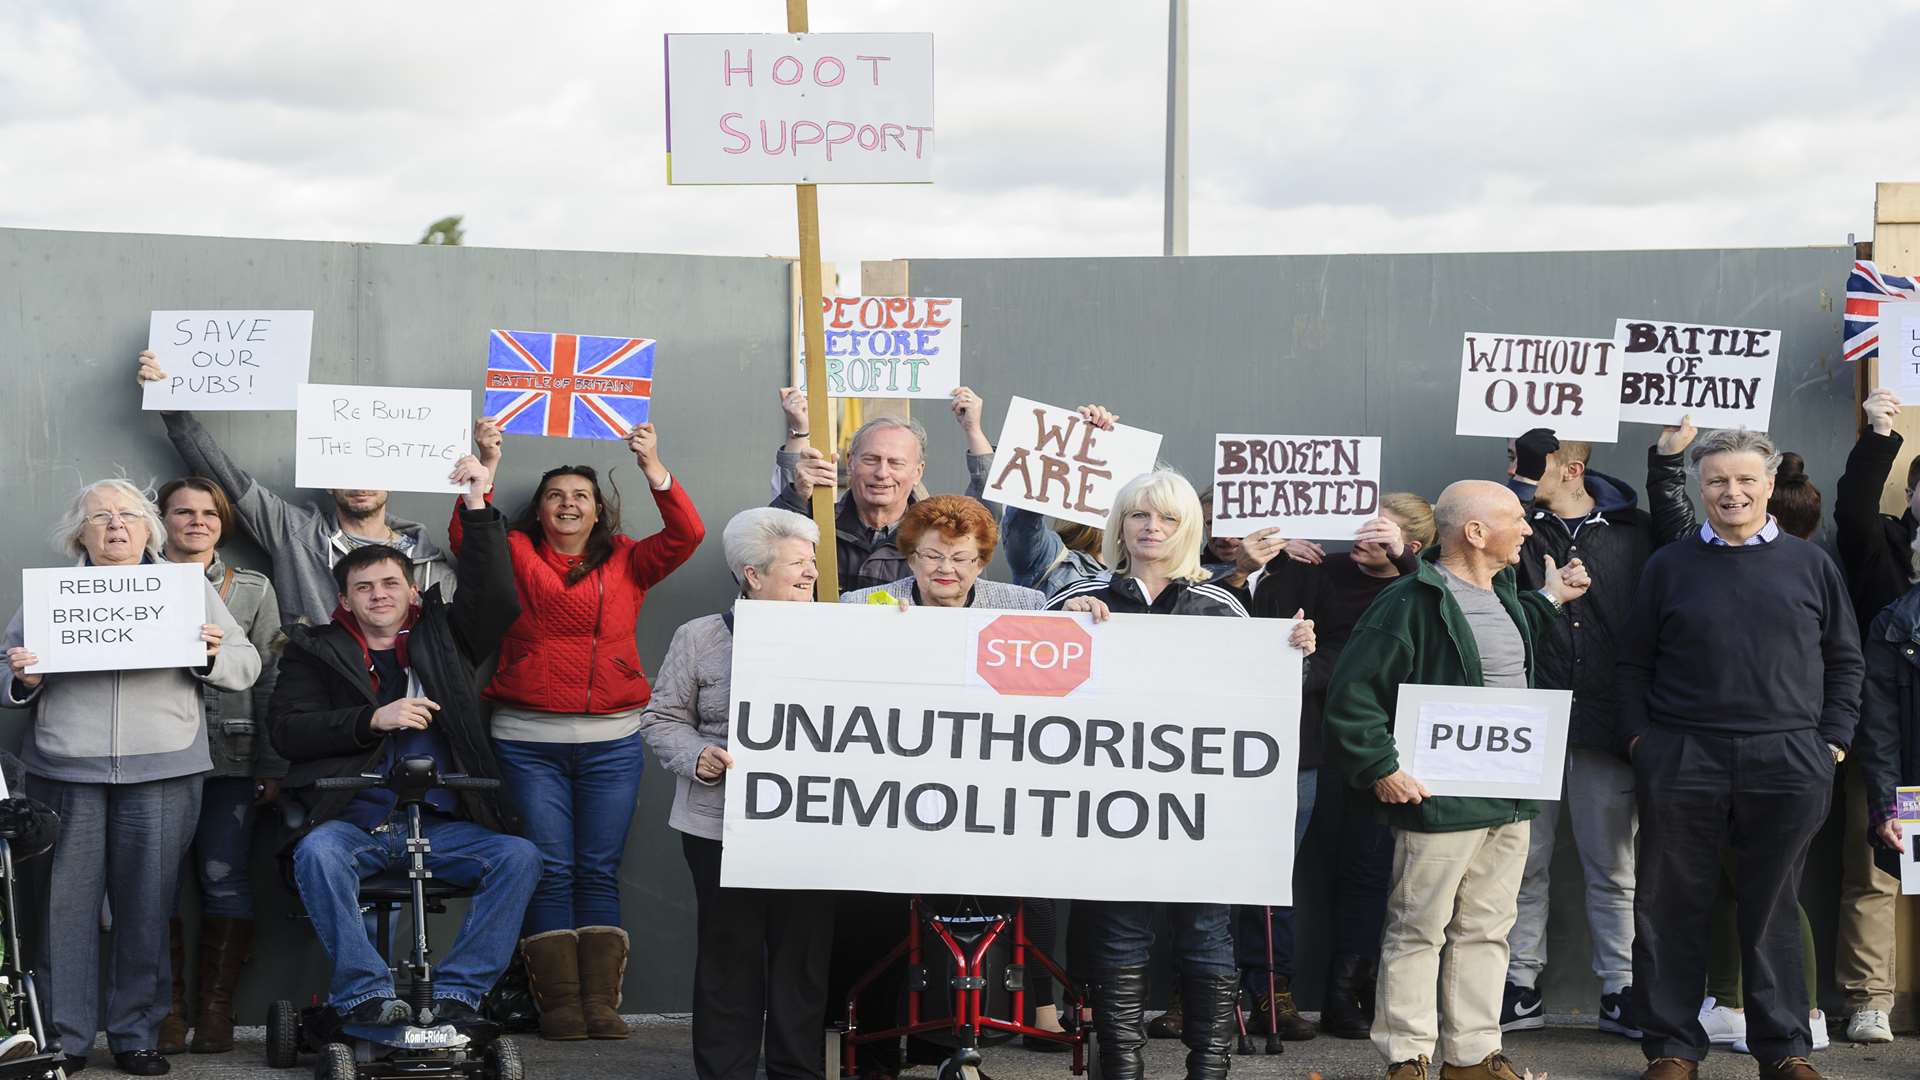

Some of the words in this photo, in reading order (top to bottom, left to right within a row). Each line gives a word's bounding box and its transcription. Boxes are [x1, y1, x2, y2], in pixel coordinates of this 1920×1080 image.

[724, 49, 891, 87] HOOT
[719, 112, 933, 161] SUPPORT
[174, 318, 271, 345] SAVE
[801, 329, 941, 357] EFORE
[1624, 323, 1771, 357] BATTLE
[192, 350, 260, 368] OUR
[1466, 337, 1616, 376] WITHOUT
[1666, 356, 1704, 376] OF
[491, 374, 550, 389] BATTLE
[554, 379, 570, 389] OF
[575, 379, 633, 392] BRITAIN
[1485, 379, 1584, 416] OUR
[1620, 372, 1762, 409] BRITAIN
[372, 400, 432, 420] BUILD
[308, 436, 353, 456] THE
[1033, 408, 1115, 466] WE
[1217, 439, 1361, 476] BROKEN
[991, 447, 1113, 518] ARE
[1216, 480, 1379, 519] HEARTED
[59, 577, 162, 595] REBUILD
[53, 605, 165, 624] BRICK-BY
[61, 628, 134, 645] BRICK
[985, 638, 1085, 670] STOP
[736, 701, 1281, 778] UNAUTHORISED
[1430, 723, 1532, 753] PUBS
[745, 771, 1206, 841] DEMOLITION
